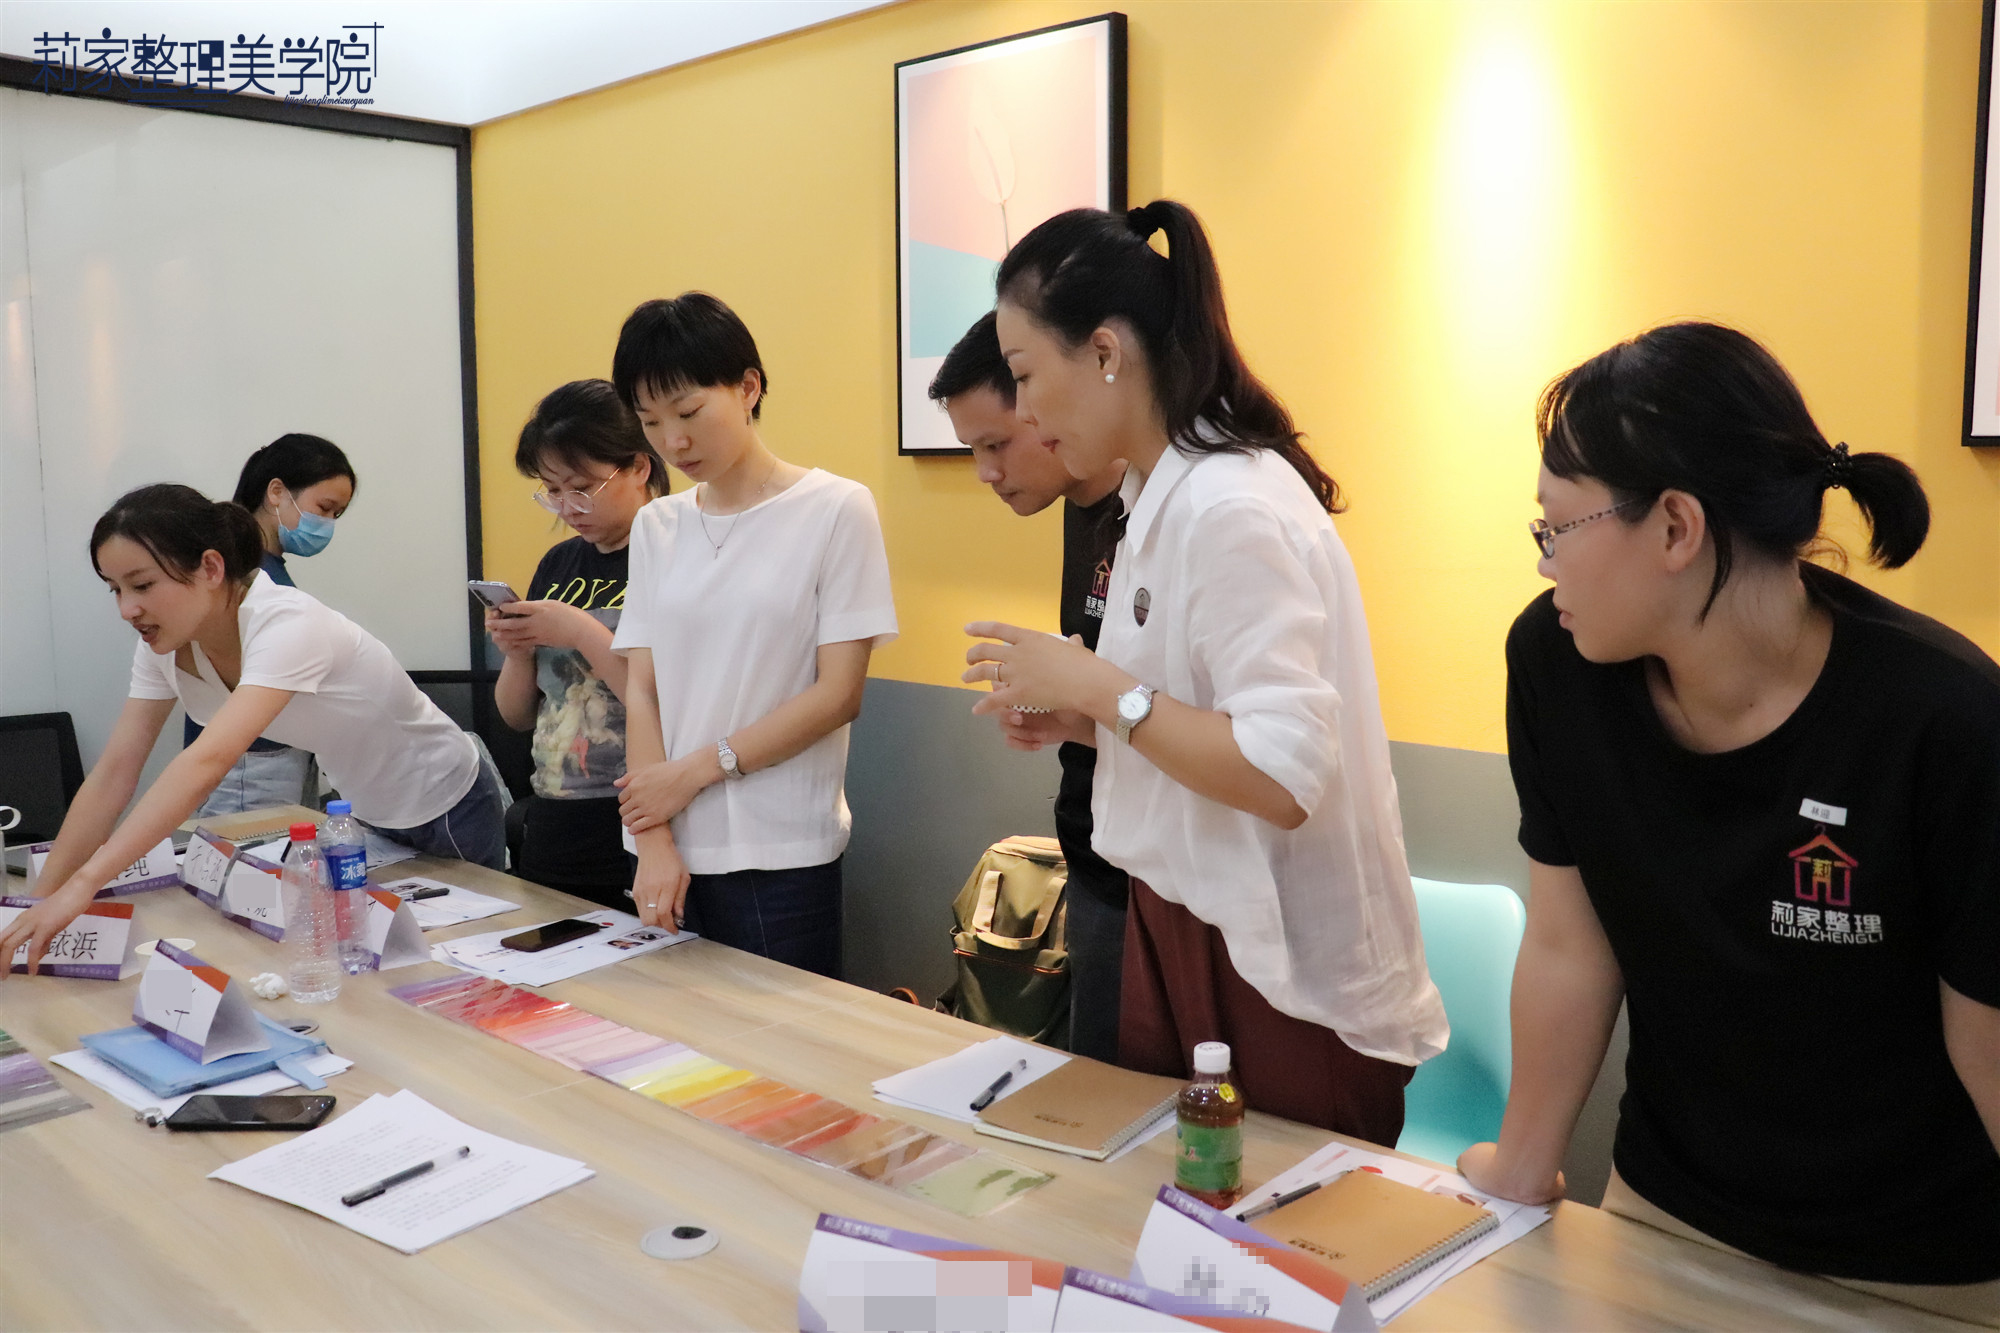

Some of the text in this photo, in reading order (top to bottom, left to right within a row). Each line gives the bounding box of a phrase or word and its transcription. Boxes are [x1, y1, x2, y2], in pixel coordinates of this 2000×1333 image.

[1771, 900, 1882, 934] 莉家整理
[1771, 921, 1884, 944] LIJIAZHENGLI
